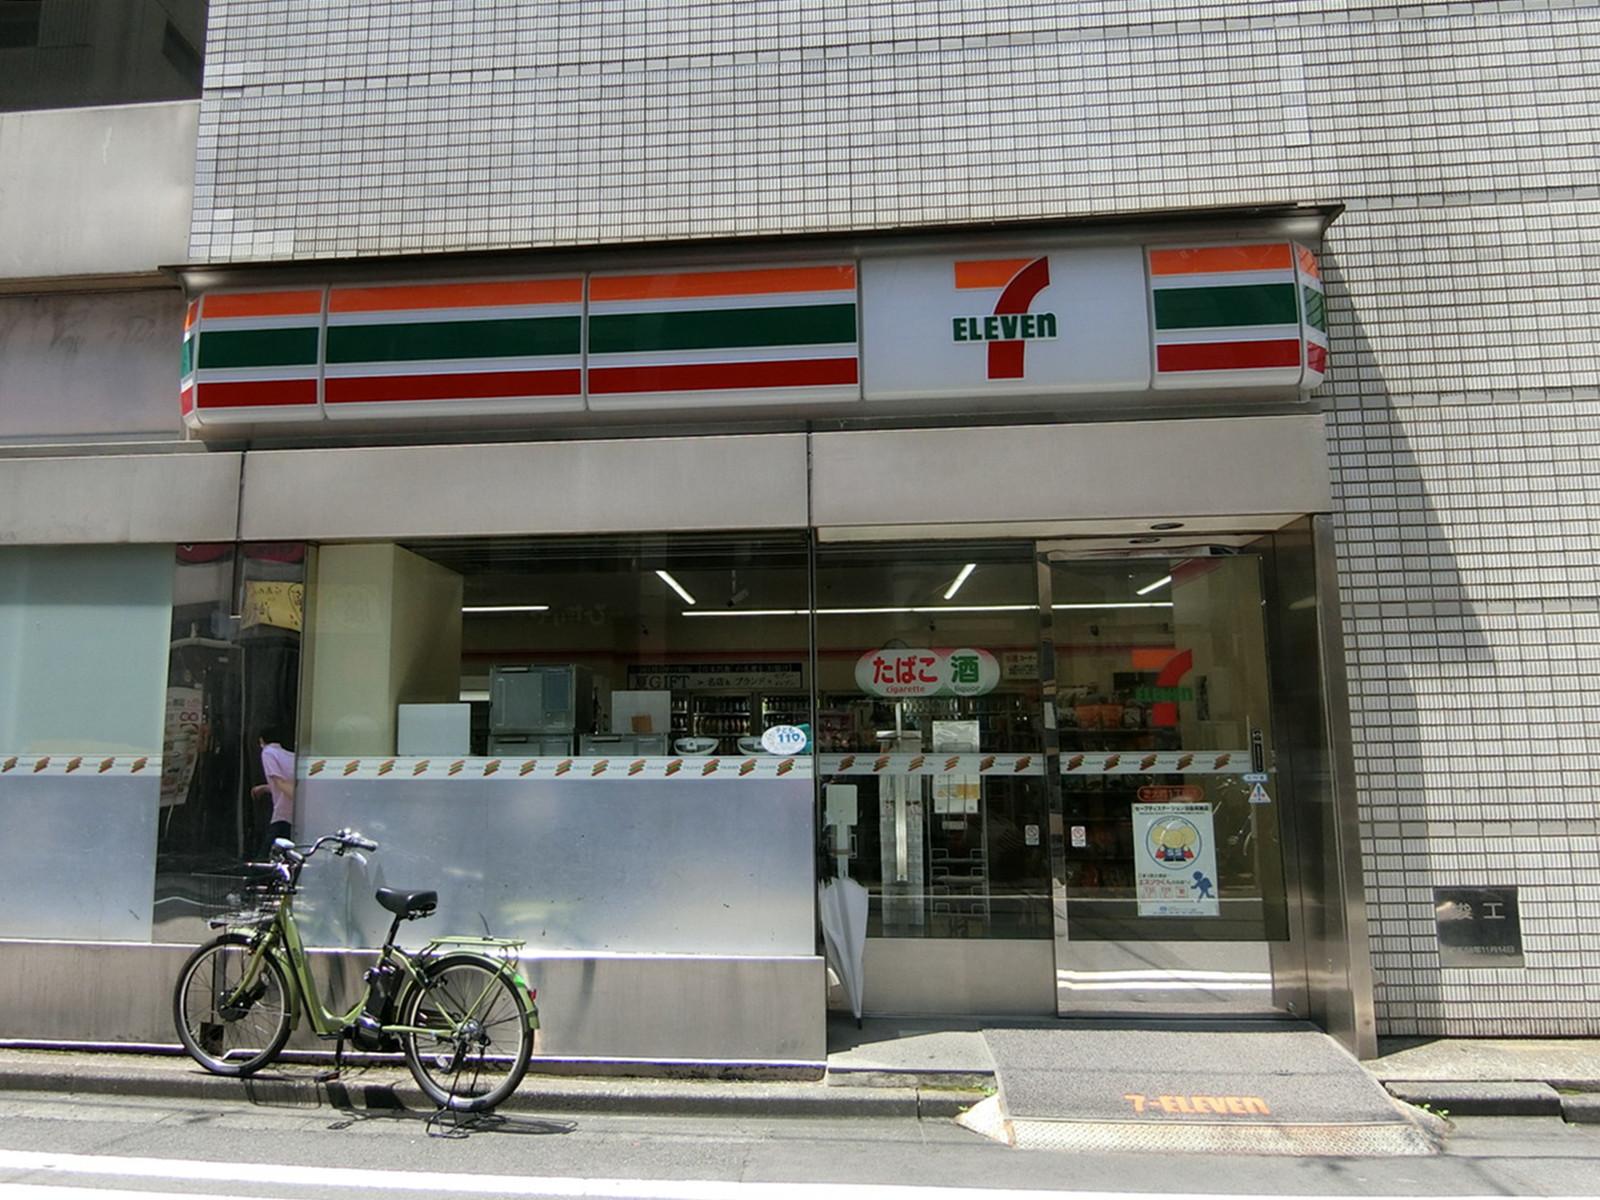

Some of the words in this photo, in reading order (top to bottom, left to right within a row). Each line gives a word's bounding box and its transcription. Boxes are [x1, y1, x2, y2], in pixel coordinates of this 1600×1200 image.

[954, 255, 1050, 380] 7
[873, 656, 938, 684] たばこ
[951, 655, 979, 683] 酒
[886, 684, 926, 694] cigarette
[954, 684, 980, 693] liquor
